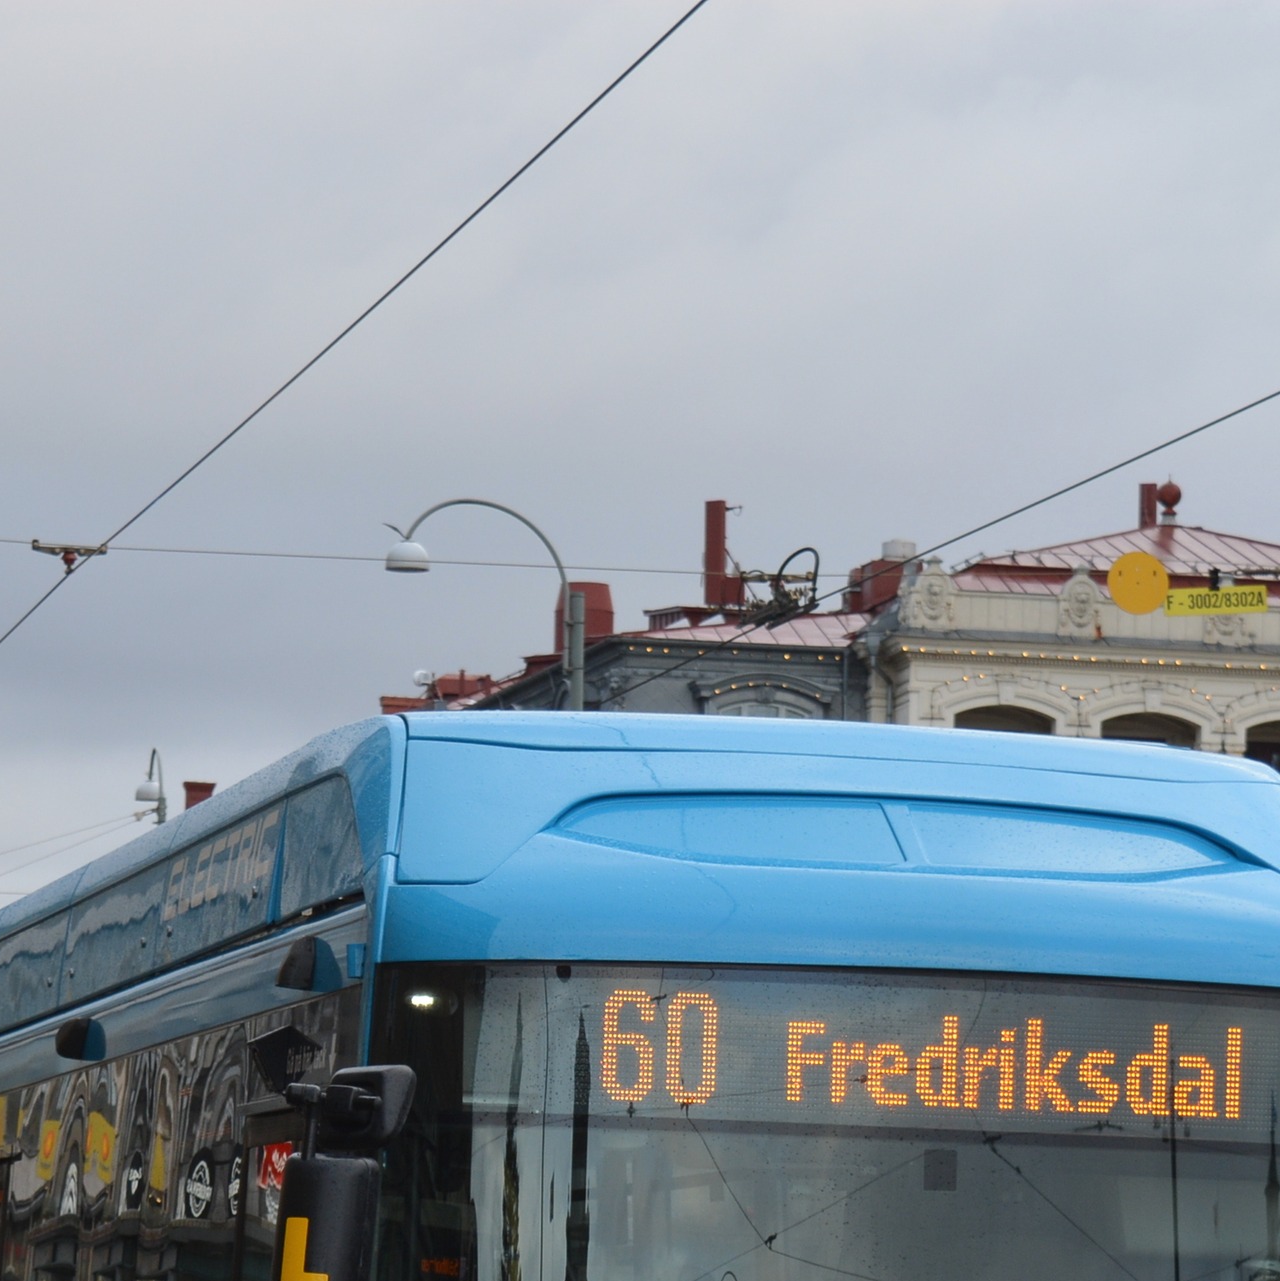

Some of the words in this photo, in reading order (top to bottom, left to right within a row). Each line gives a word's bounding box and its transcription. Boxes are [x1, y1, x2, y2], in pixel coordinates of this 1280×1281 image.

[1187, 590, 1265, 610] 3002/8302A
[163, 810, 279, 921] ELECTRIC
[600, 989, 718, 1105] 60
[786, 1015, 1241, 1120] Fredriksdal
